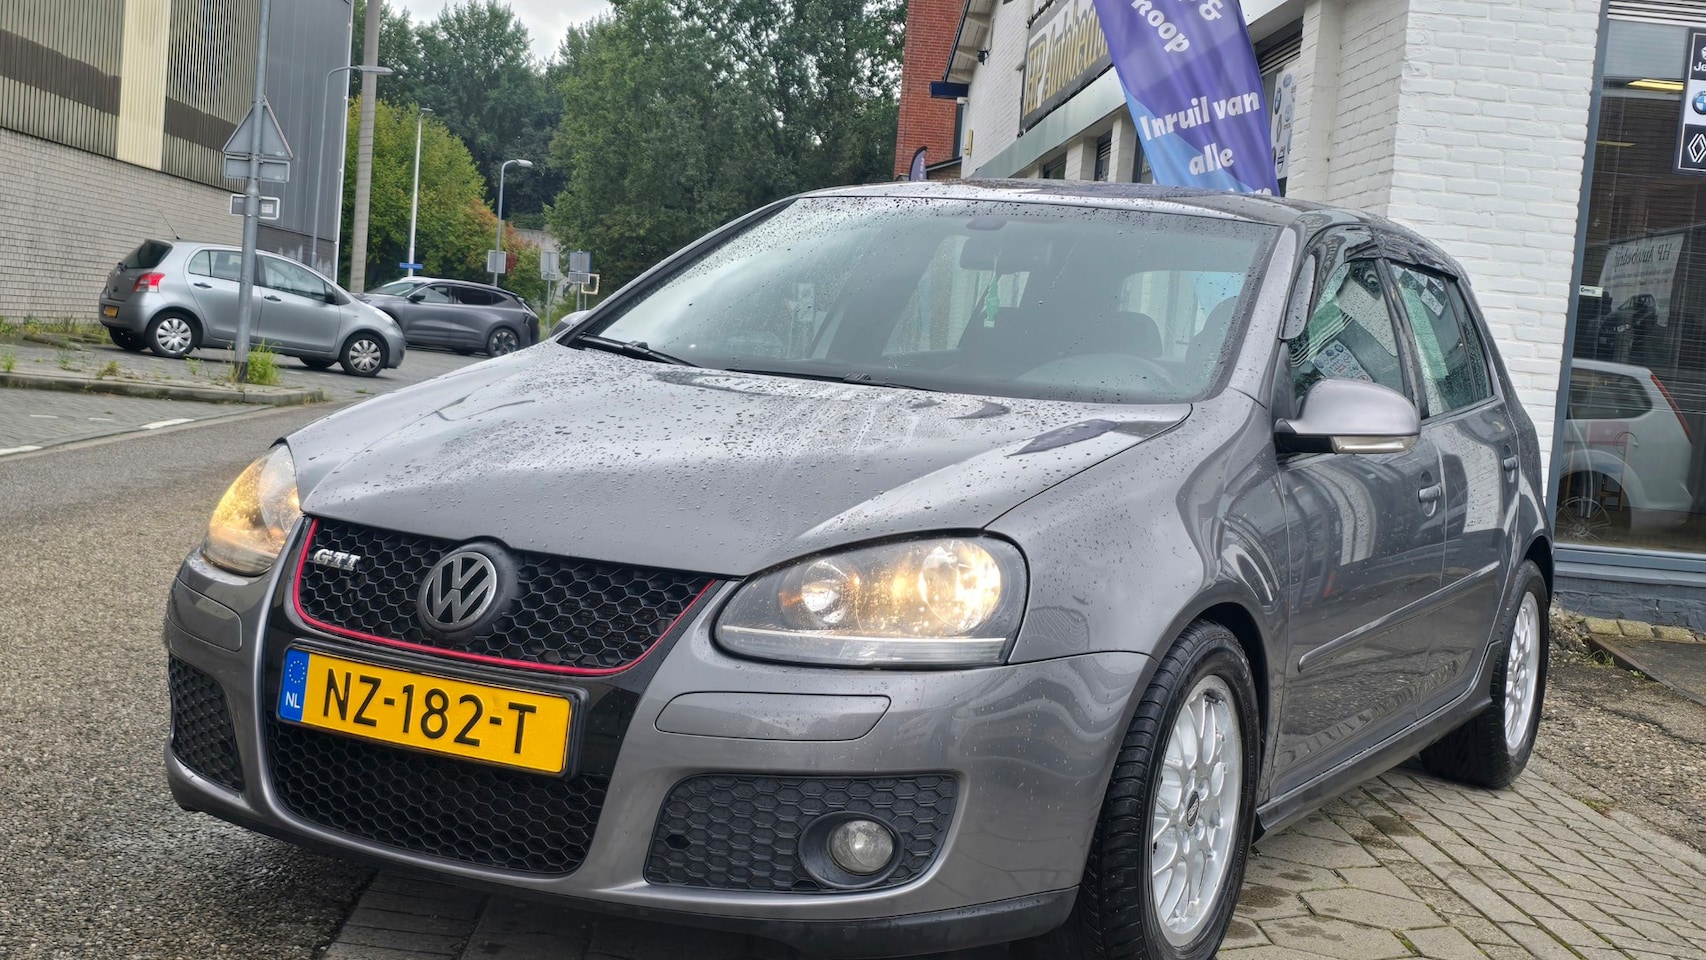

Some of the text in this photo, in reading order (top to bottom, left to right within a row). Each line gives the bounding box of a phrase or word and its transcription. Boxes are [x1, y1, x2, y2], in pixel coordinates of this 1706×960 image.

[1140, 96, 1210, 141] Inruil
[1212, 91, 1260, 120] van
[1189, 143, 1234, 176] alle
[313, 548, 361, 571] GTI
[285, 690, 301, 709] NL
[322, 667, 538, 755] NZ-182-T
